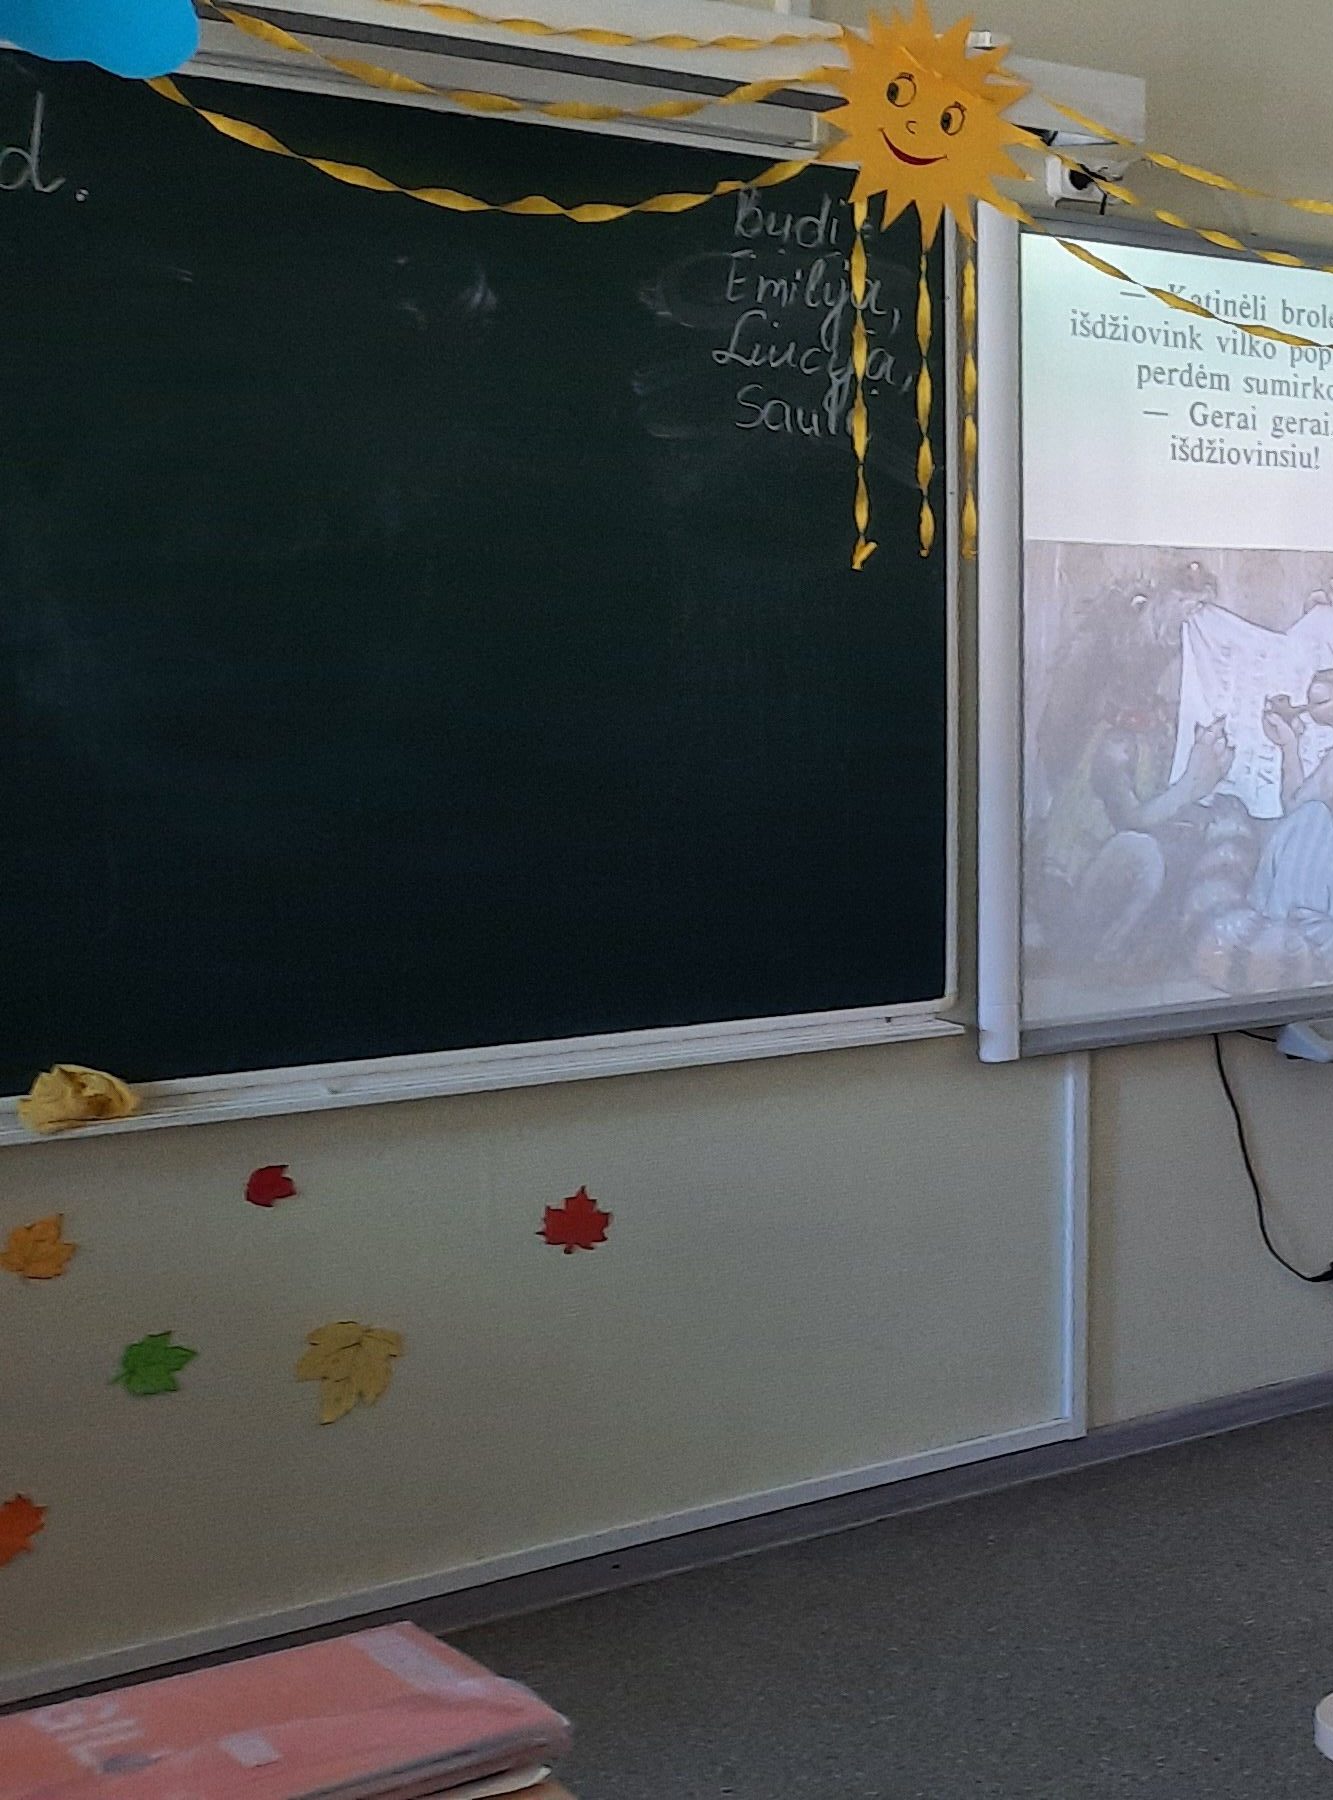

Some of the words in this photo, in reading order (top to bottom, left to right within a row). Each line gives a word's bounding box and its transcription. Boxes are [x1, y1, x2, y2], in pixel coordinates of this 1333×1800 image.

[1070, 308, 1204, 351] išdžiovink
[1216, 328, 1277, 361] vilko
[1137, 362, 1231, 392] perdėm
[735, 383, 873, 438] Saul
[1189, 401, 1257, 431] Gerai
[1170, 434, 1320, 470] išdžiovinsiu!
